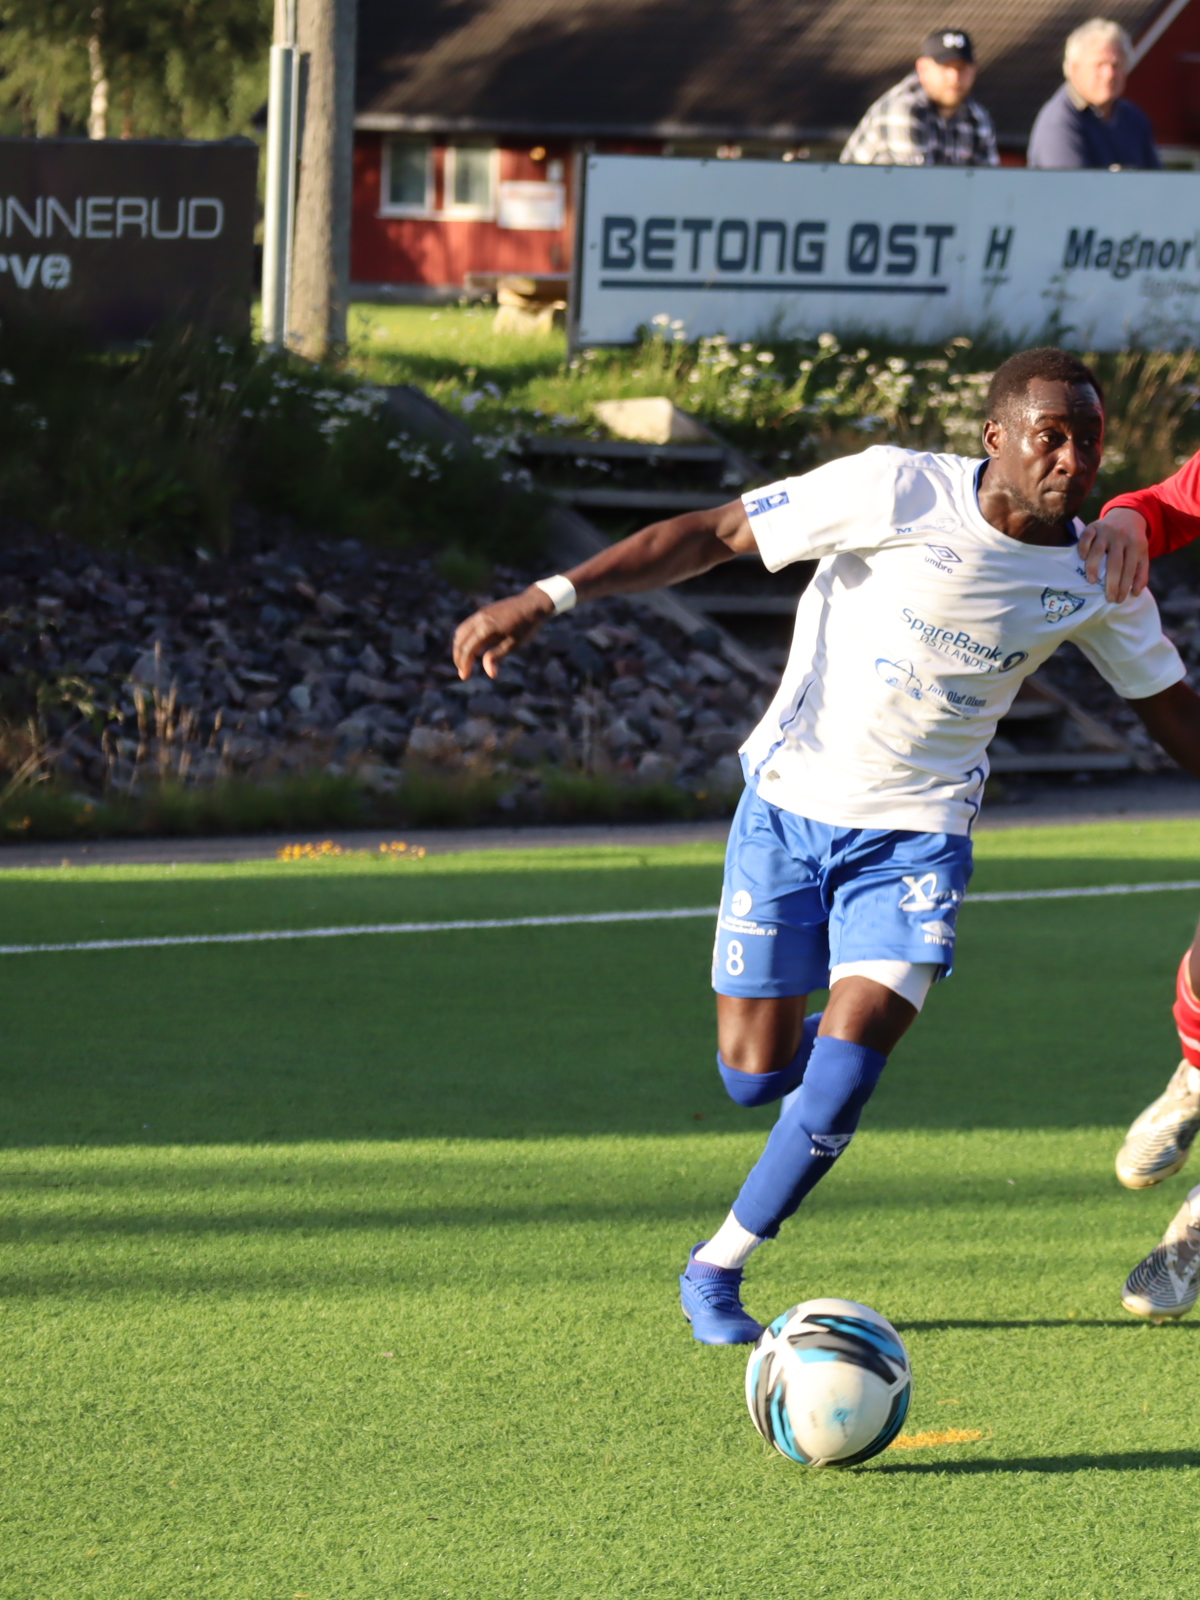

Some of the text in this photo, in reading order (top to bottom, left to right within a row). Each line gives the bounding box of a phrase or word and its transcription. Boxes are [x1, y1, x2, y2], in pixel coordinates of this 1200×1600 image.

[0, 196, 224, 239] NNERUD
[602, 216, 955, 277] BETONG ØST
[924, 556, 953, 574] umbro
[900, 607, 1003, 661] SpareBank
[920, 634, 997, 673] ØSTLANDET
[946, 691, 967, 705] Olaf
[726, 940, 745, 976] 8
